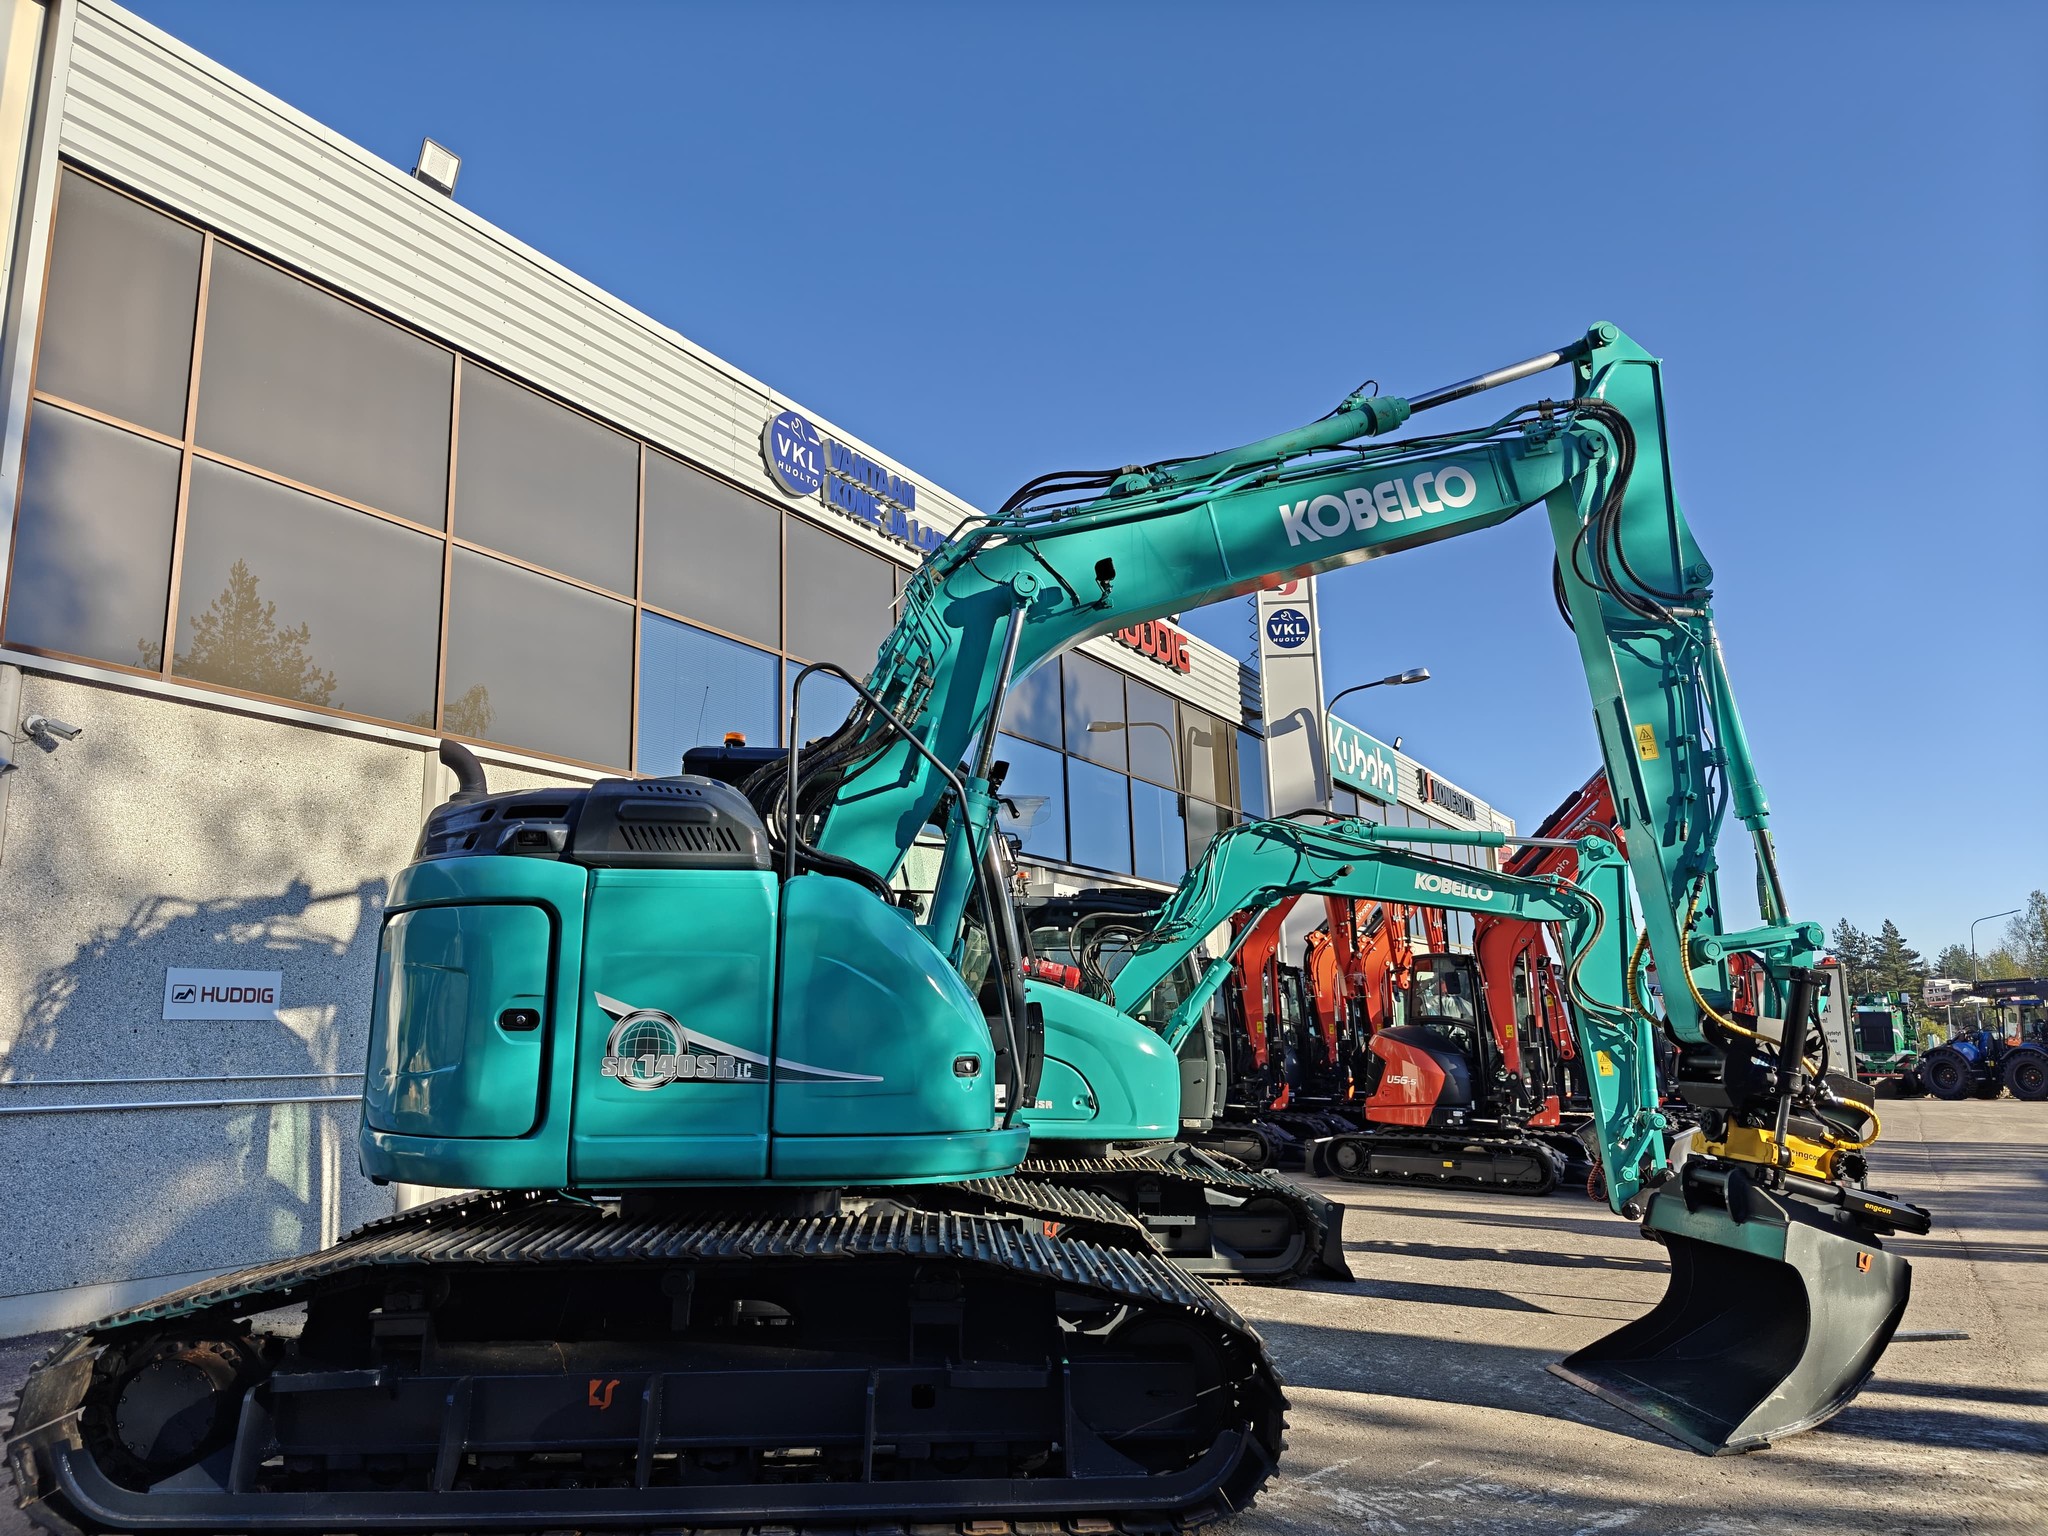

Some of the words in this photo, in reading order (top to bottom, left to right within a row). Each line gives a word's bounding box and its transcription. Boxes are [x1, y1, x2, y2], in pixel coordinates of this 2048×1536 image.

[777, 433, 820, 476] VKL
[777, 459, 819, 488] HUOLTO
[823, 438, 916, 512] VANTAAN
[1279, 466, 1477, 547] KOBELCO
[1271, 623, 1306, 636] VKL
[1118, 620, 1190, 674] UDDIG
[1327, 720, 1395, 796] Kubota
[1414, 872, 1494, 902] KOBELCO
[1356, 903, 1372, 922] ubota
[200, 986, 274, 1004] HUDDIG
[736, 1063, 752, 1078] LC
[1864, 1202, 1892, 1215] engcon
